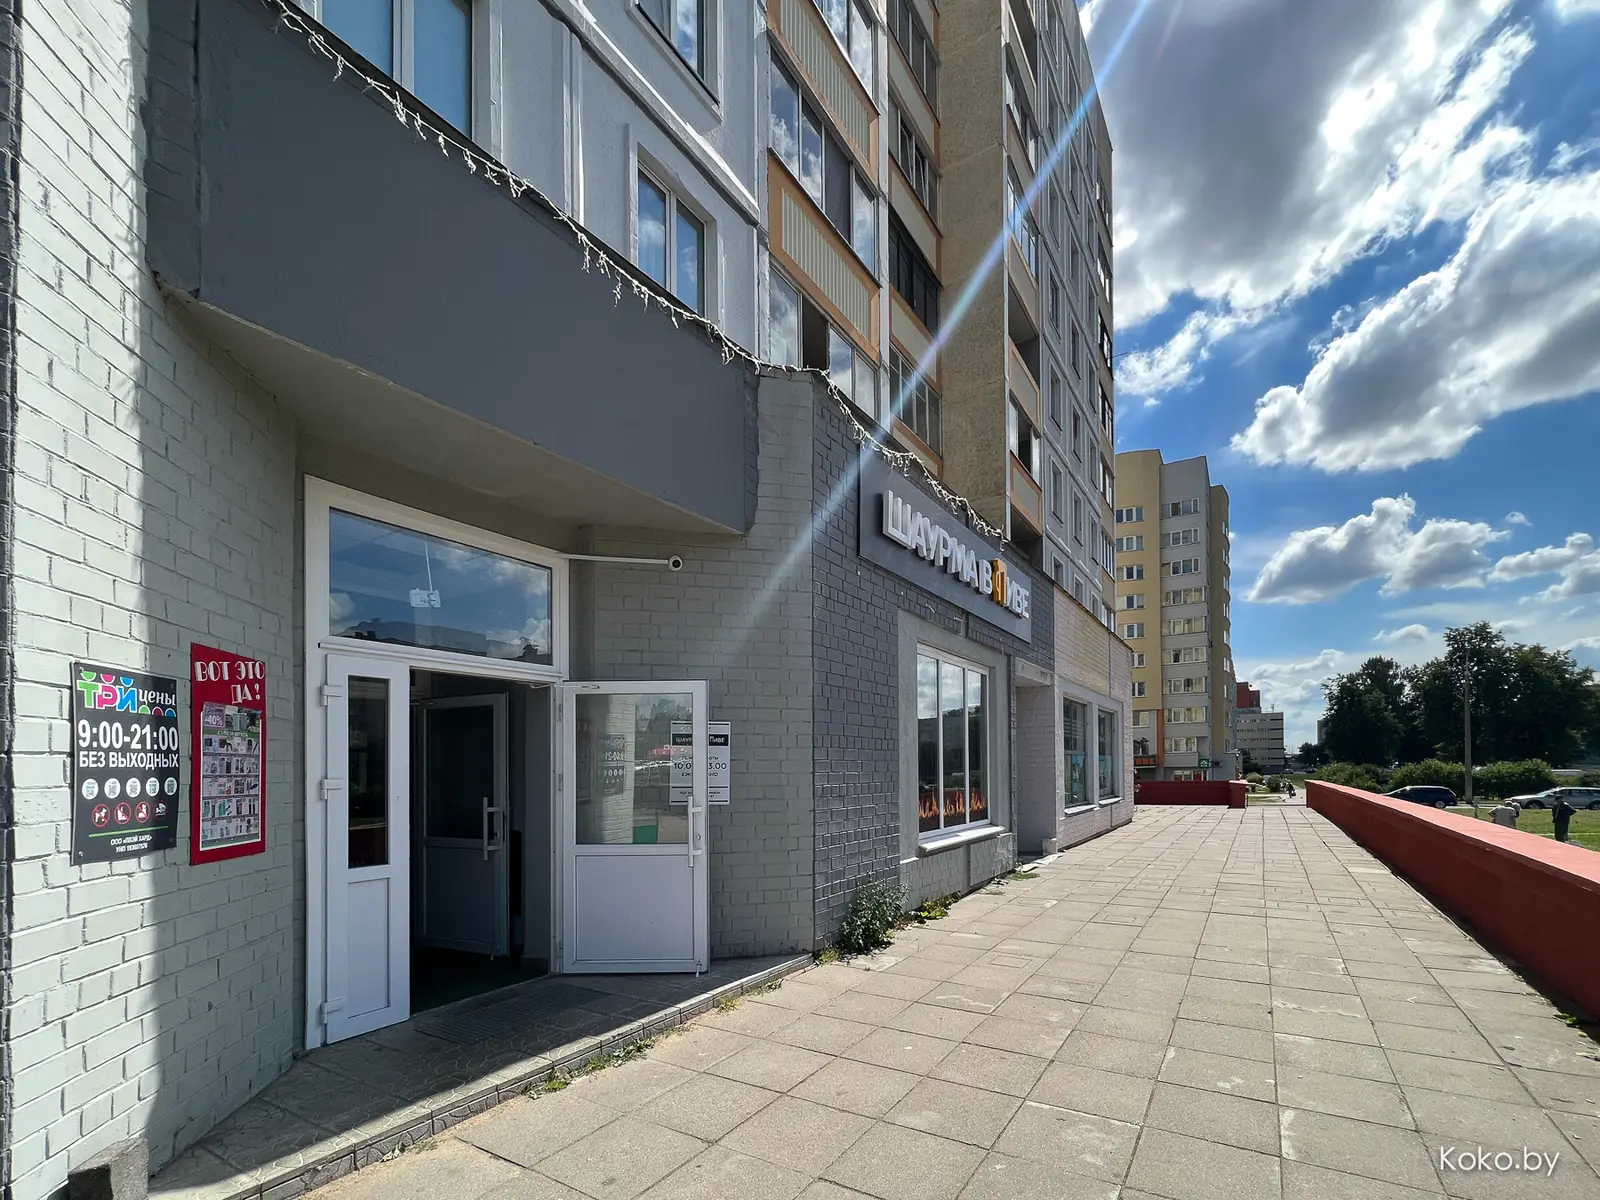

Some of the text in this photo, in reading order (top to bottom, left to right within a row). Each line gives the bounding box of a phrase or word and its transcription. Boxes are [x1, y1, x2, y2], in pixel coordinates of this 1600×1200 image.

[194, 660, 265, 682] ВОТ ЭТО
[138, 689, 176, 707] цены
[78, 719, 179, 751] 9:00-21:00
[79, 751, 179, 770] БЕЗ ВЫХОДНЫХ
